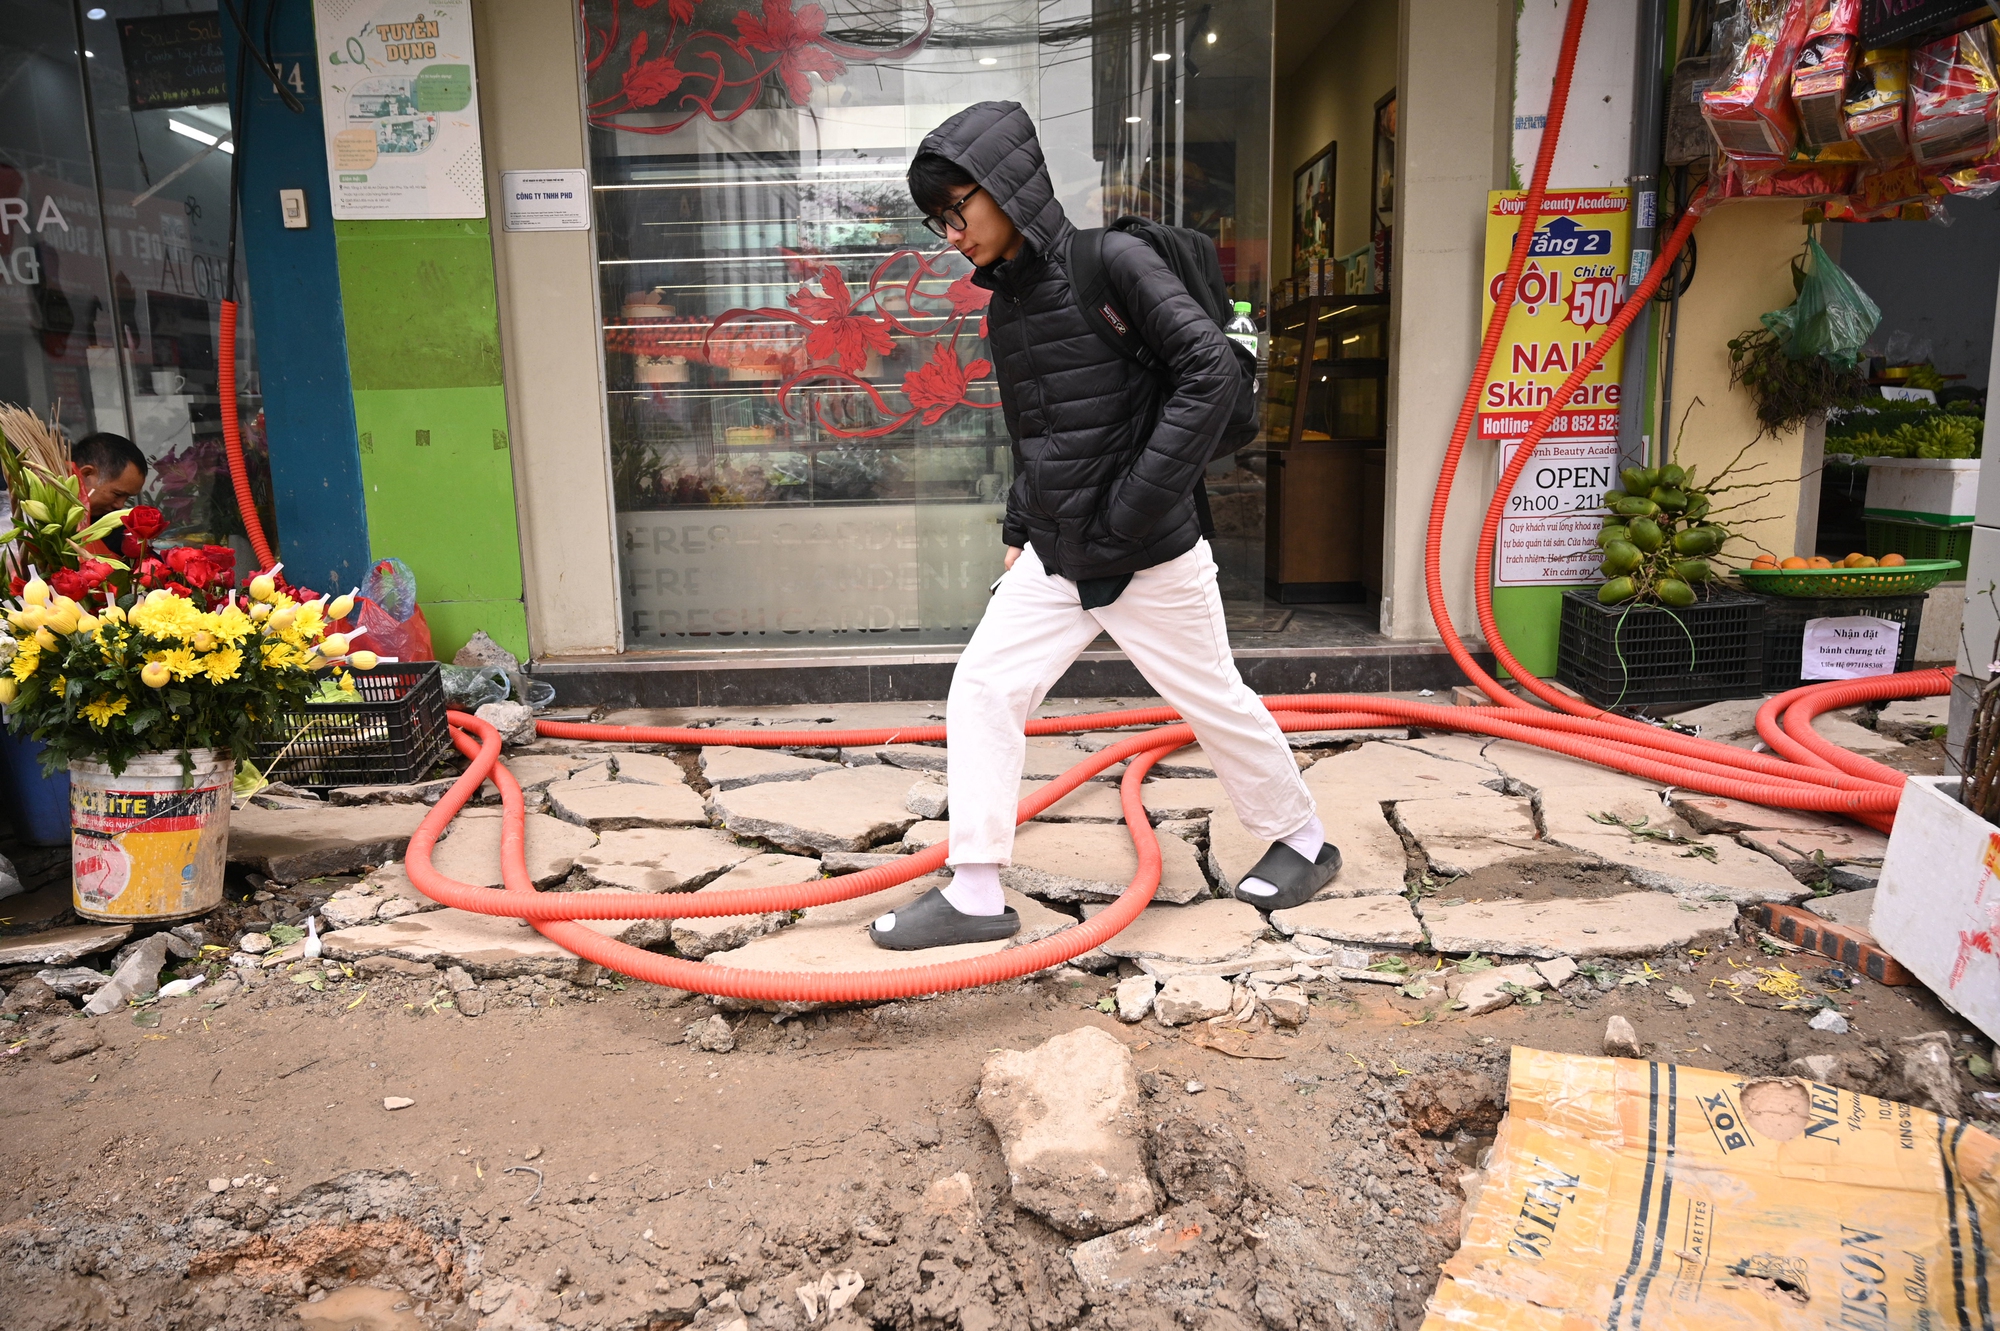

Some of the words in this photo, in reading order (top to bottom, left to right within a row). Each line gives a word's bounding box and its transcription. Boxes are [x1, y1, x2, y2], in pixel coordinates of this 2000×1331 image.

[376, 13, 439, 42] TUYỂN
[385, 41, 436, 65] DỤNG
[534, 192, 542, 200] TY
[543, 191, 559, 200] TNHH
[1500, 197, 1527, 214] Quỳn
[1576, 195, 1628, 211] Academy
[1584, 234, 1600, 251] 2
[1574, 265, 1598, 277] Chỉ
[1600, 266, 1615, 277] từ
[1483, 418, 1533, 435] Hotline:
[1571, 415, 1595, 432] 852
[1553, 446, 1585, 456] Beauty
[1587, 445, 1618, 455] Acade
[1536, 467, 1610, 489] OPEN
[1512, 495, 1559, 511] 9h00
[1547, 523, 1558, 531] vui
[1542, 568, 1558, 577] Xin
[1833, 628, 1860, 640] Nhận
[1862, 629, 1879, 640] đặt
[1819, 645, 1842, 654] bánh
[1844, 645, 1873, 656] chưng
[1875, 645, 1886, 655] tết
[1703, 1093, 1747, 1151] BOX
[1899, 1119, 1915, 1150] KING
[1902, 1249, 1929, 1304] Blend
